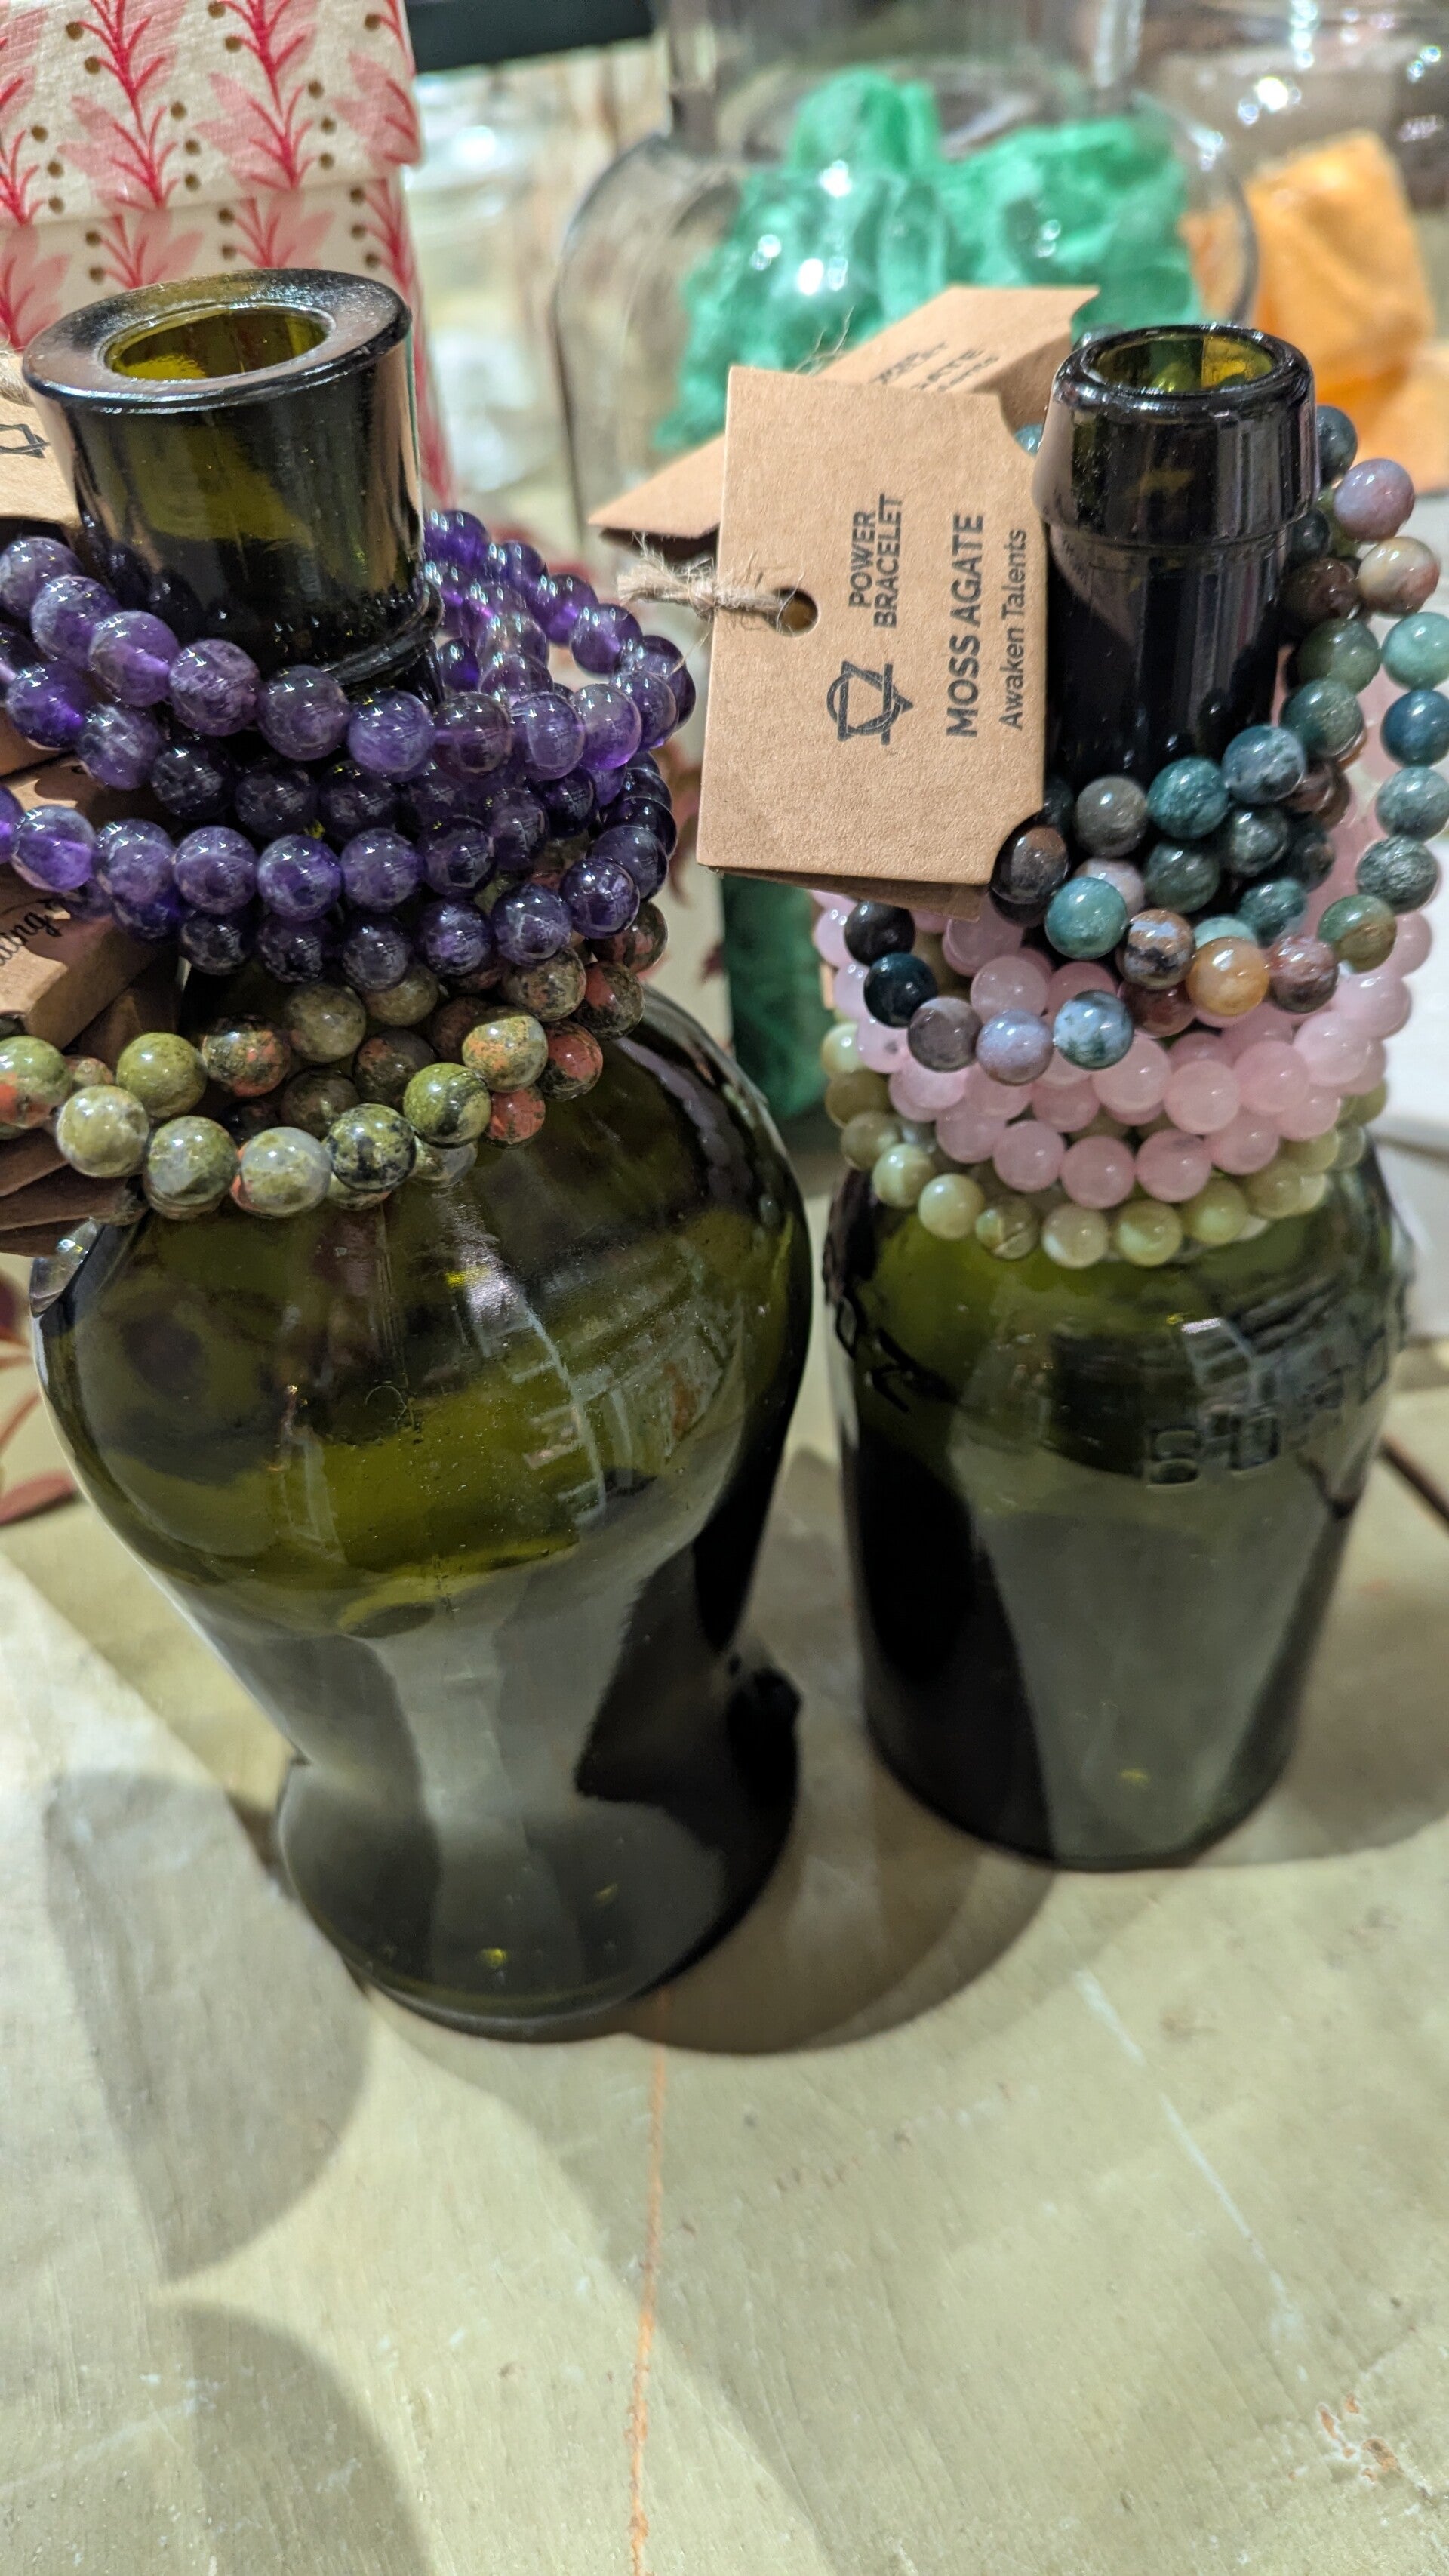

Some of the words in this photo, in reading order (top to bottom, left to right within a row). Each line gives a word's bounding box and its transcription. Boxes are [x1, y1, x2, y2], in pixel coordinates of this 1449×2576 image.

[849, 510, 876, 608] POWER
[873, 494, 903, 629] BRACELET
[949, 513, 984, 628] AGATE
[1001, 528, 1027, 620] Talents
[946, 634, 980, 738] MOSS
[998, 627, 1025, 731] Awaken
